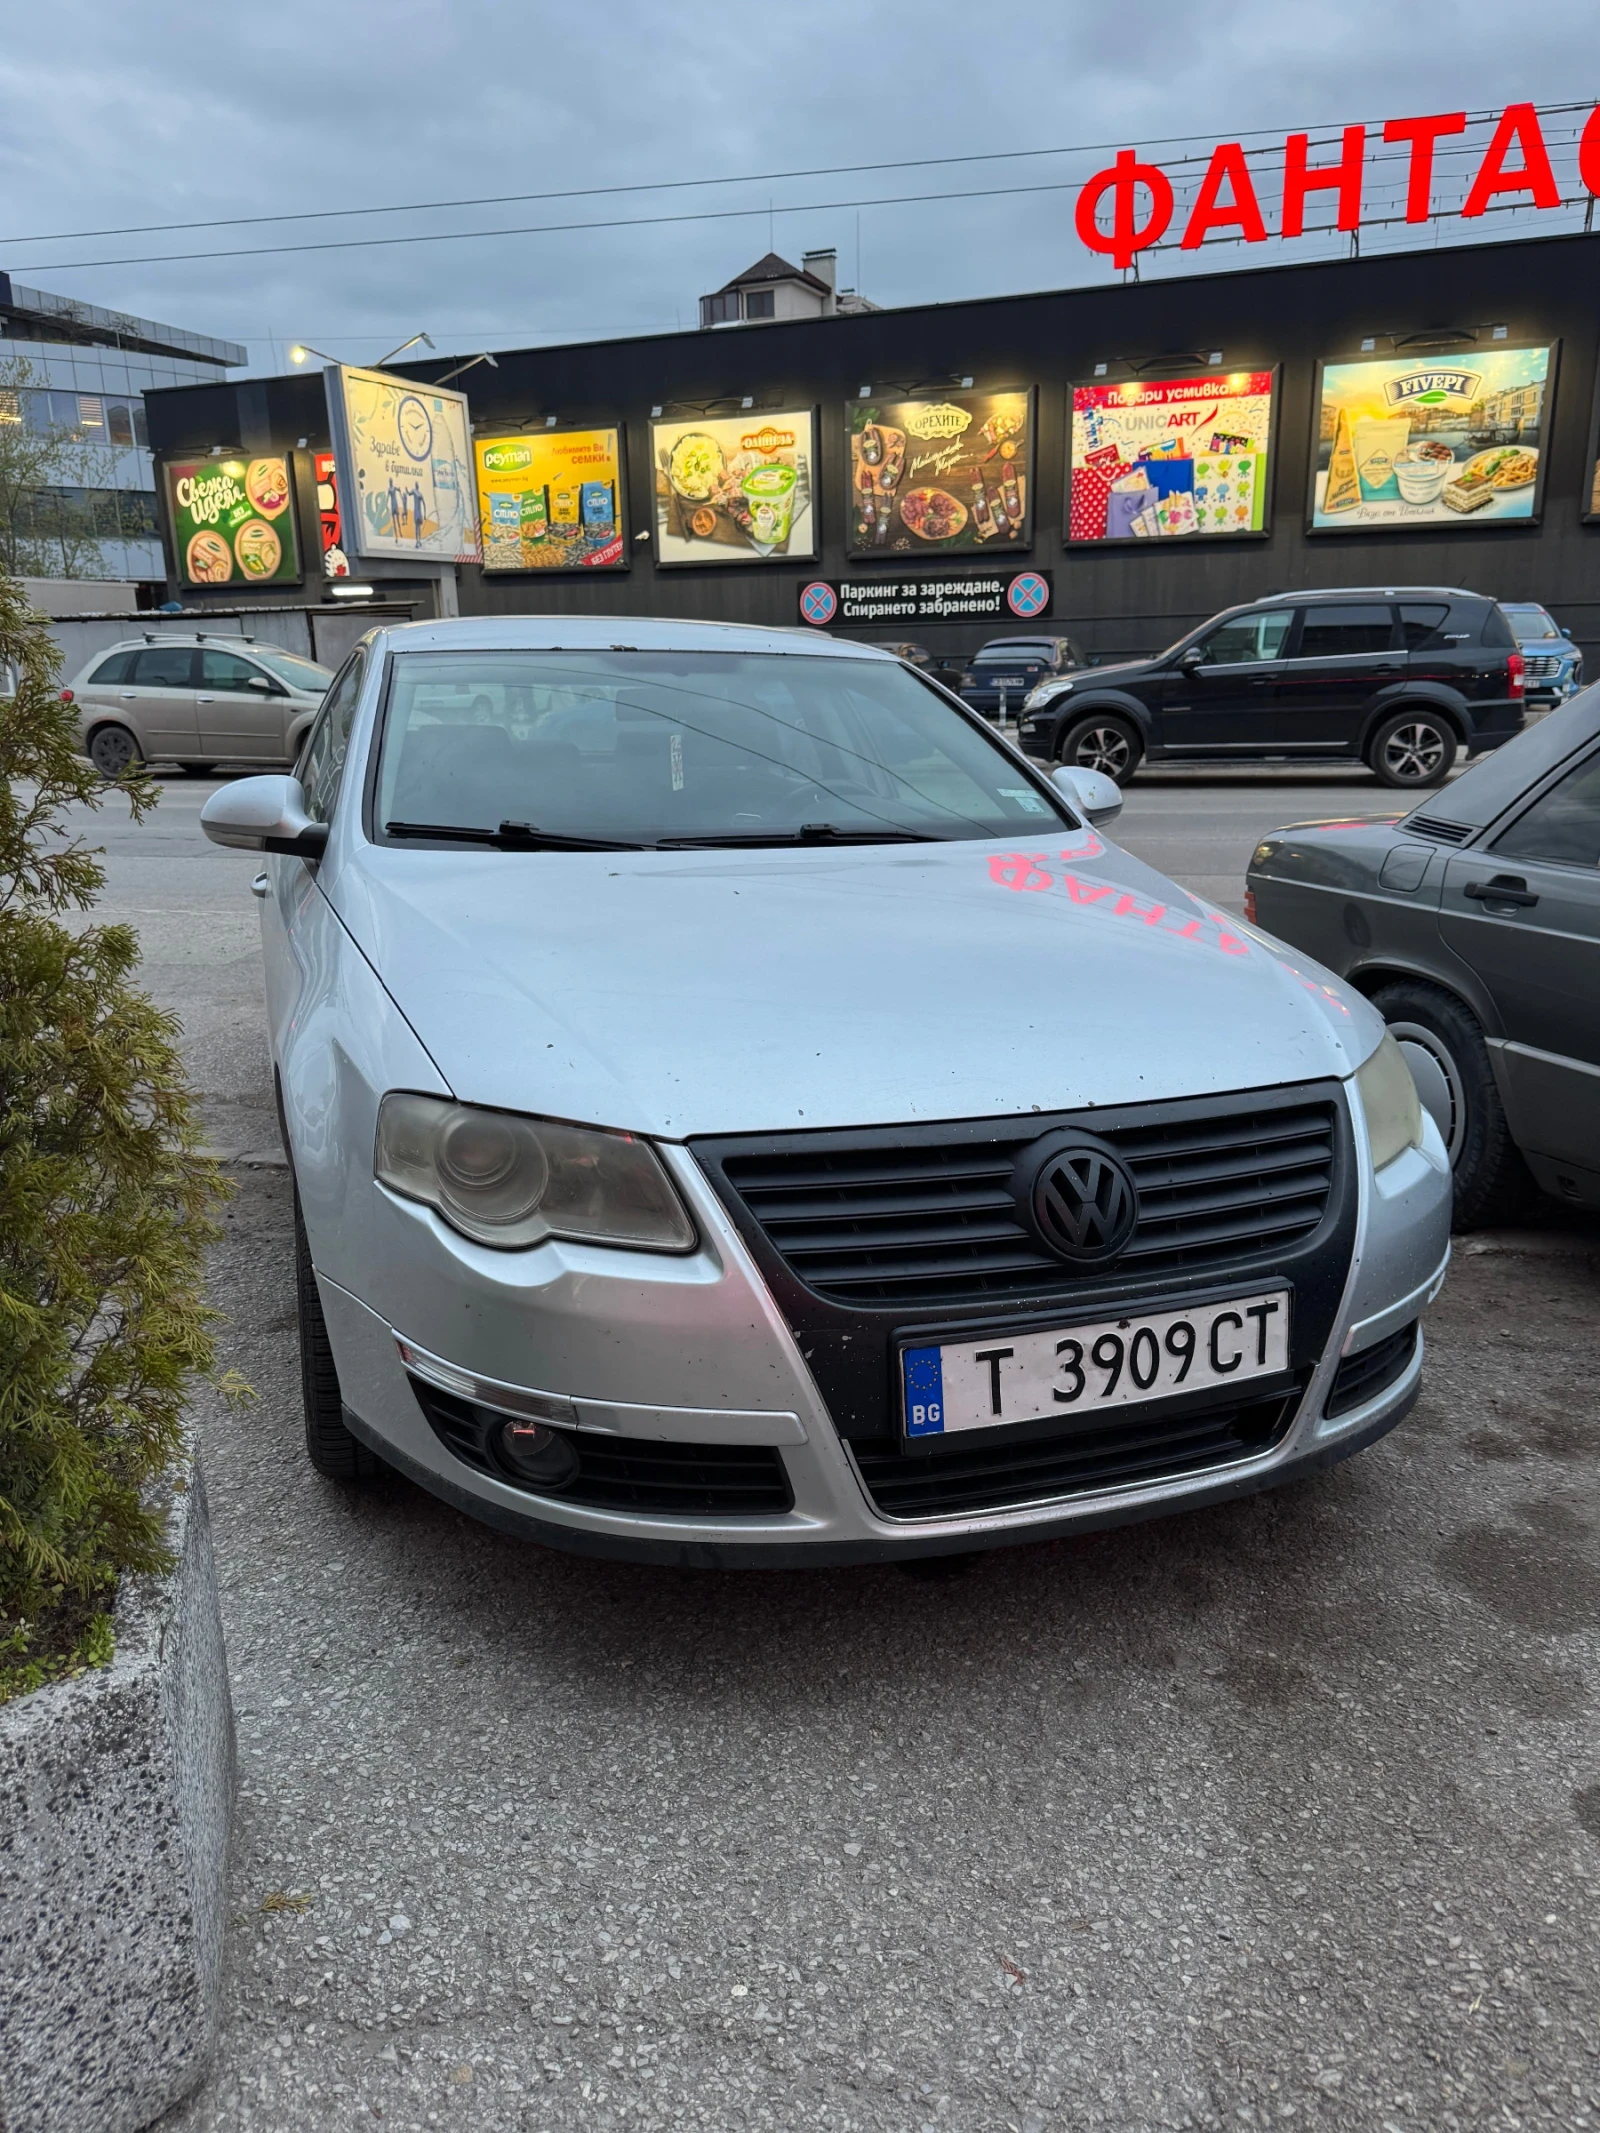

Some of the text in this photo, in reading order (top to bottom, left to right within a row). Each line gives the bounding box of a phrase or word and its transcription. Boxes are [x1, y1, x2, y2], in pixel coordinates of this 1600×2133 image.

[1075, 103, 1600, 269] ФАНТА
[1400, 375, 1465, 395] FIVEPI
[1108, 390, 1162, 406] Подари
[915, 415, 961, 429] ОРЕХИТЕ
[1126, 412, 1200, 431] UNICART
[369, 435, 400, 458] Здраве
[552, 443, 604, 456] Любимите Ви
[485, 450, 531, 467] peyman
[391, 460, 423, 477] бутилка
[177, 476, 234, 507] Свежа
[591, 553, 604, 565] БЕЗ
[840, 579, 1005, 601] Паркинг за зареждане.
[843, 595, 1001, 619] Спирането забранено!
[912, 1404, 940, 1425] BG
[975, 1347, 1014, 1415] T
